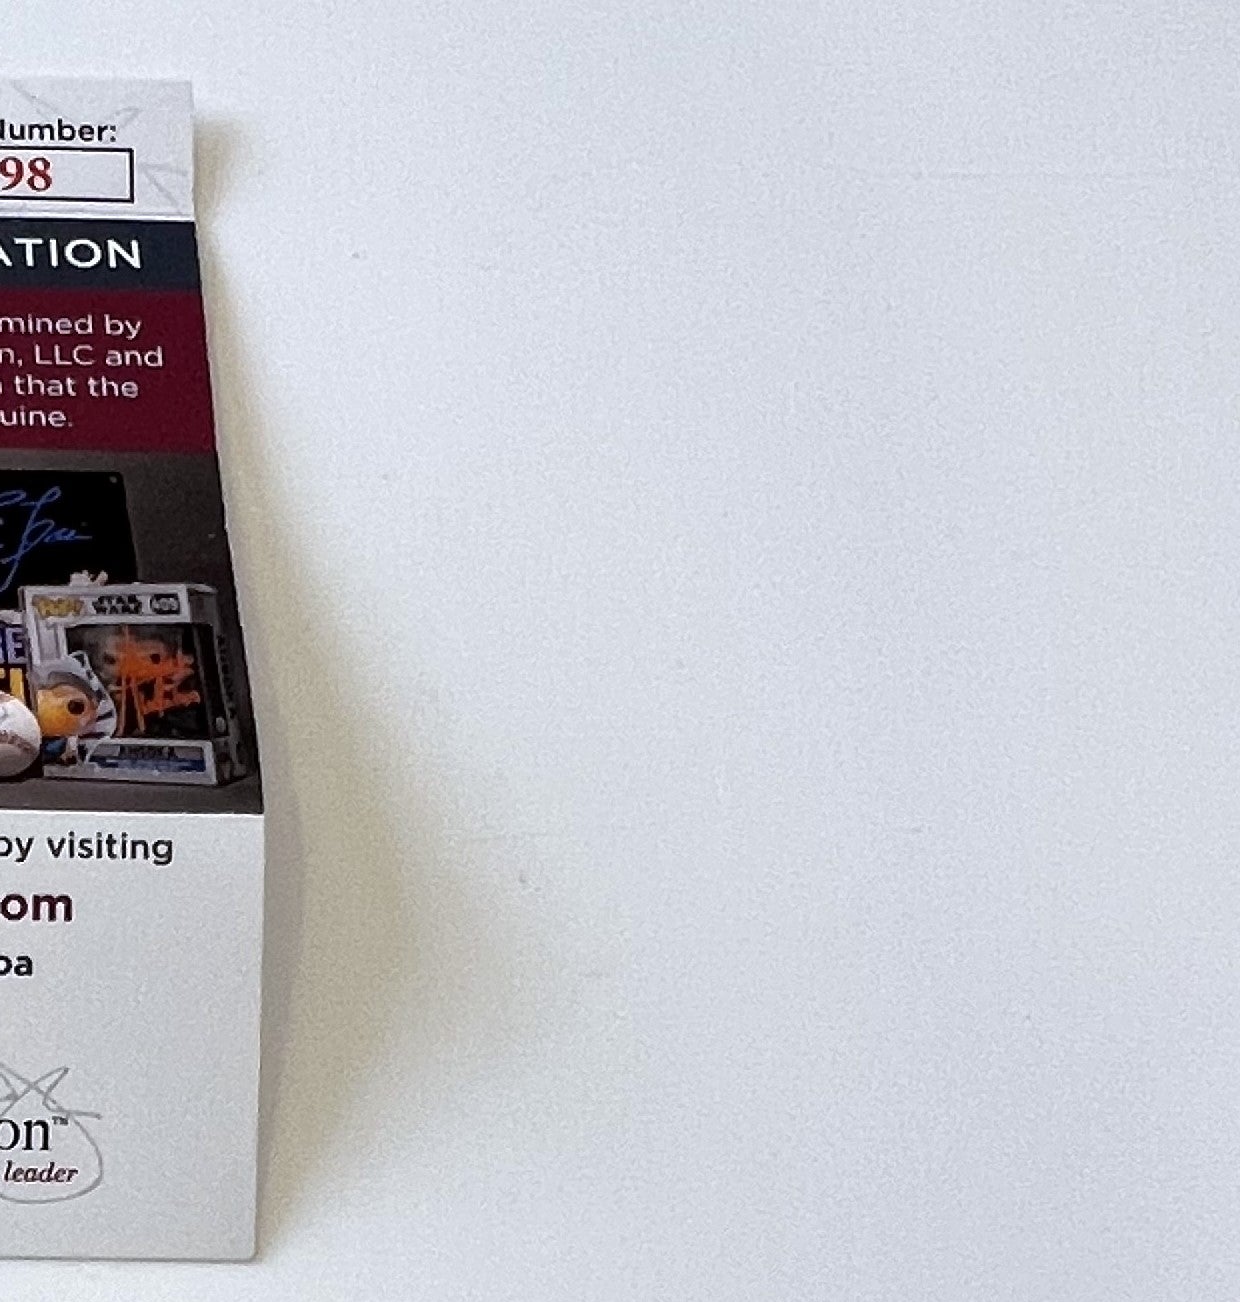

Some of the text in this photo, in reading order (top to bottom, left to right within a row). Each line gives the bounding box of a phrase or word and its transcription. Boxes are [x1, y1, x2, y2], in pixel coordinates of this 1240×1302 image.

[103, 314, 141, 340] by
[35, 344, 94, 366] LLC
[105, 345, 163, 367] and
[14, 373, 77, 397] that
[87, 375, 139, 398] the
[46, 830, 173, 867] visiting
[3, 1160, 79, 1183] leader
